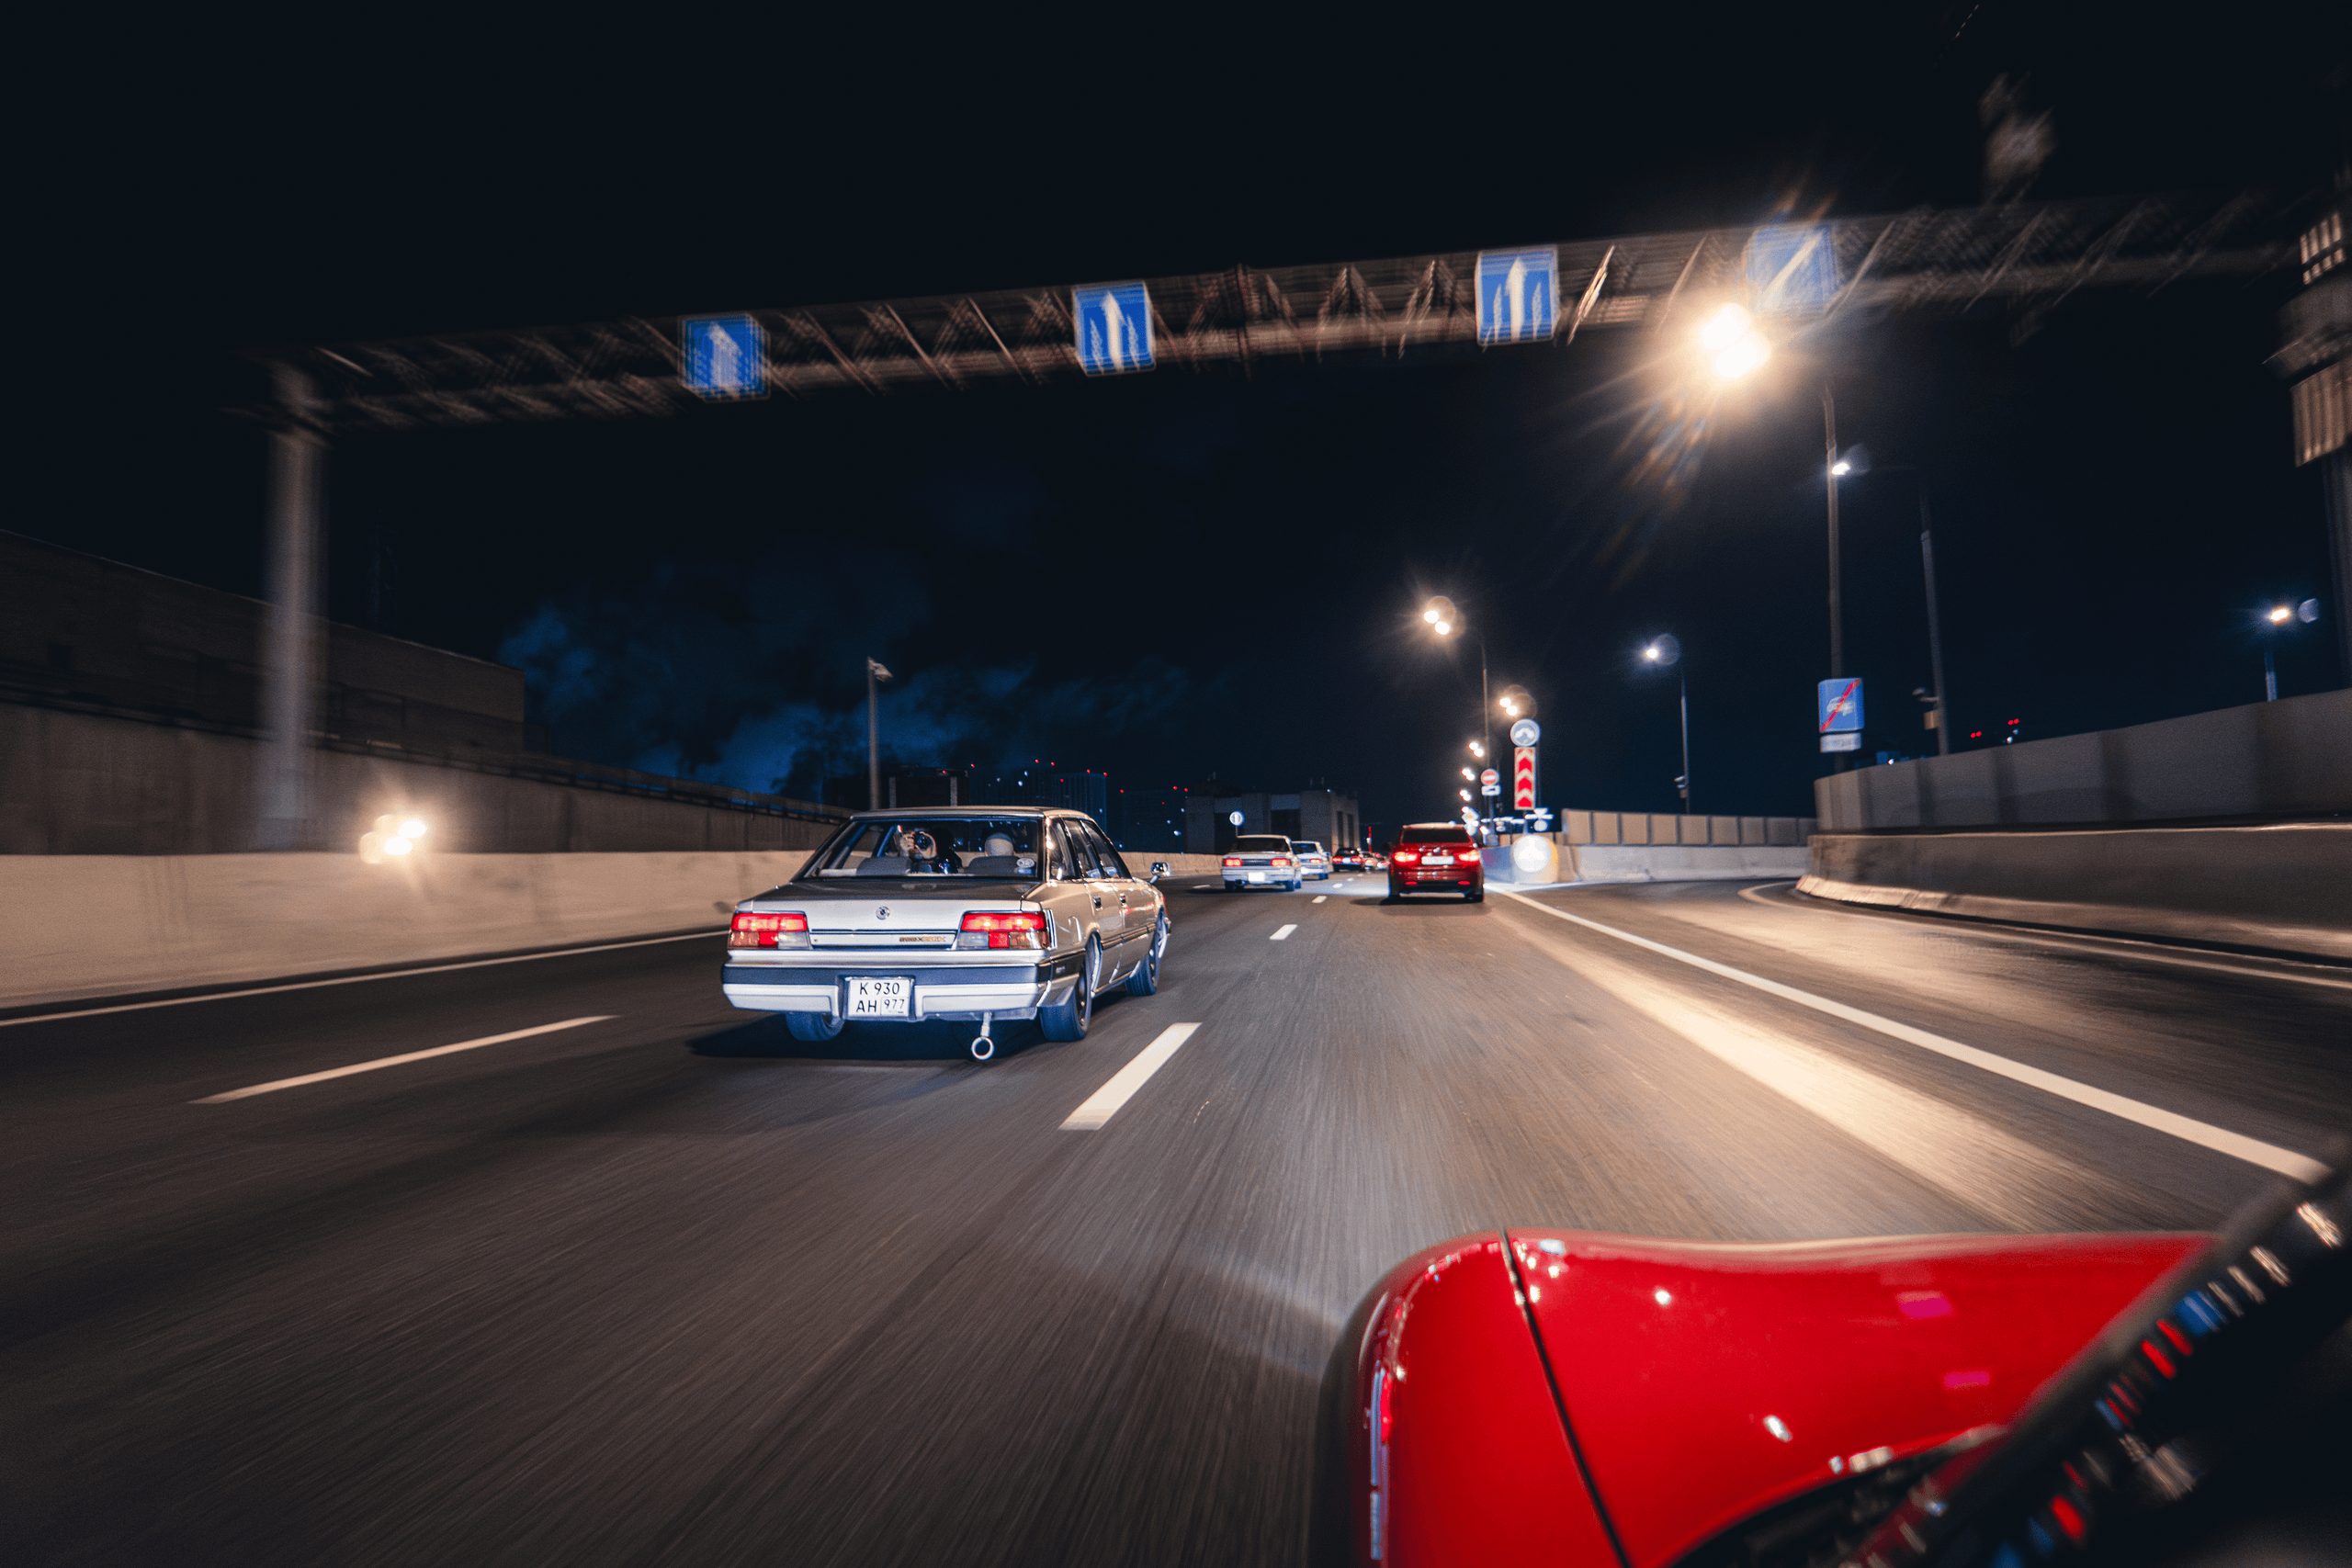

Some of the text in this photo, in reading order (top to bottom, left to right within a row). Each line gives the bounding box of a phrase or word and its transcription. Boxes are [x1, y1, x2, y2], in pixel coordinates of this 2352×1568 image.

[859, 982, 900, 995] К 930
[855, 998, 905, 1012] АН 977
